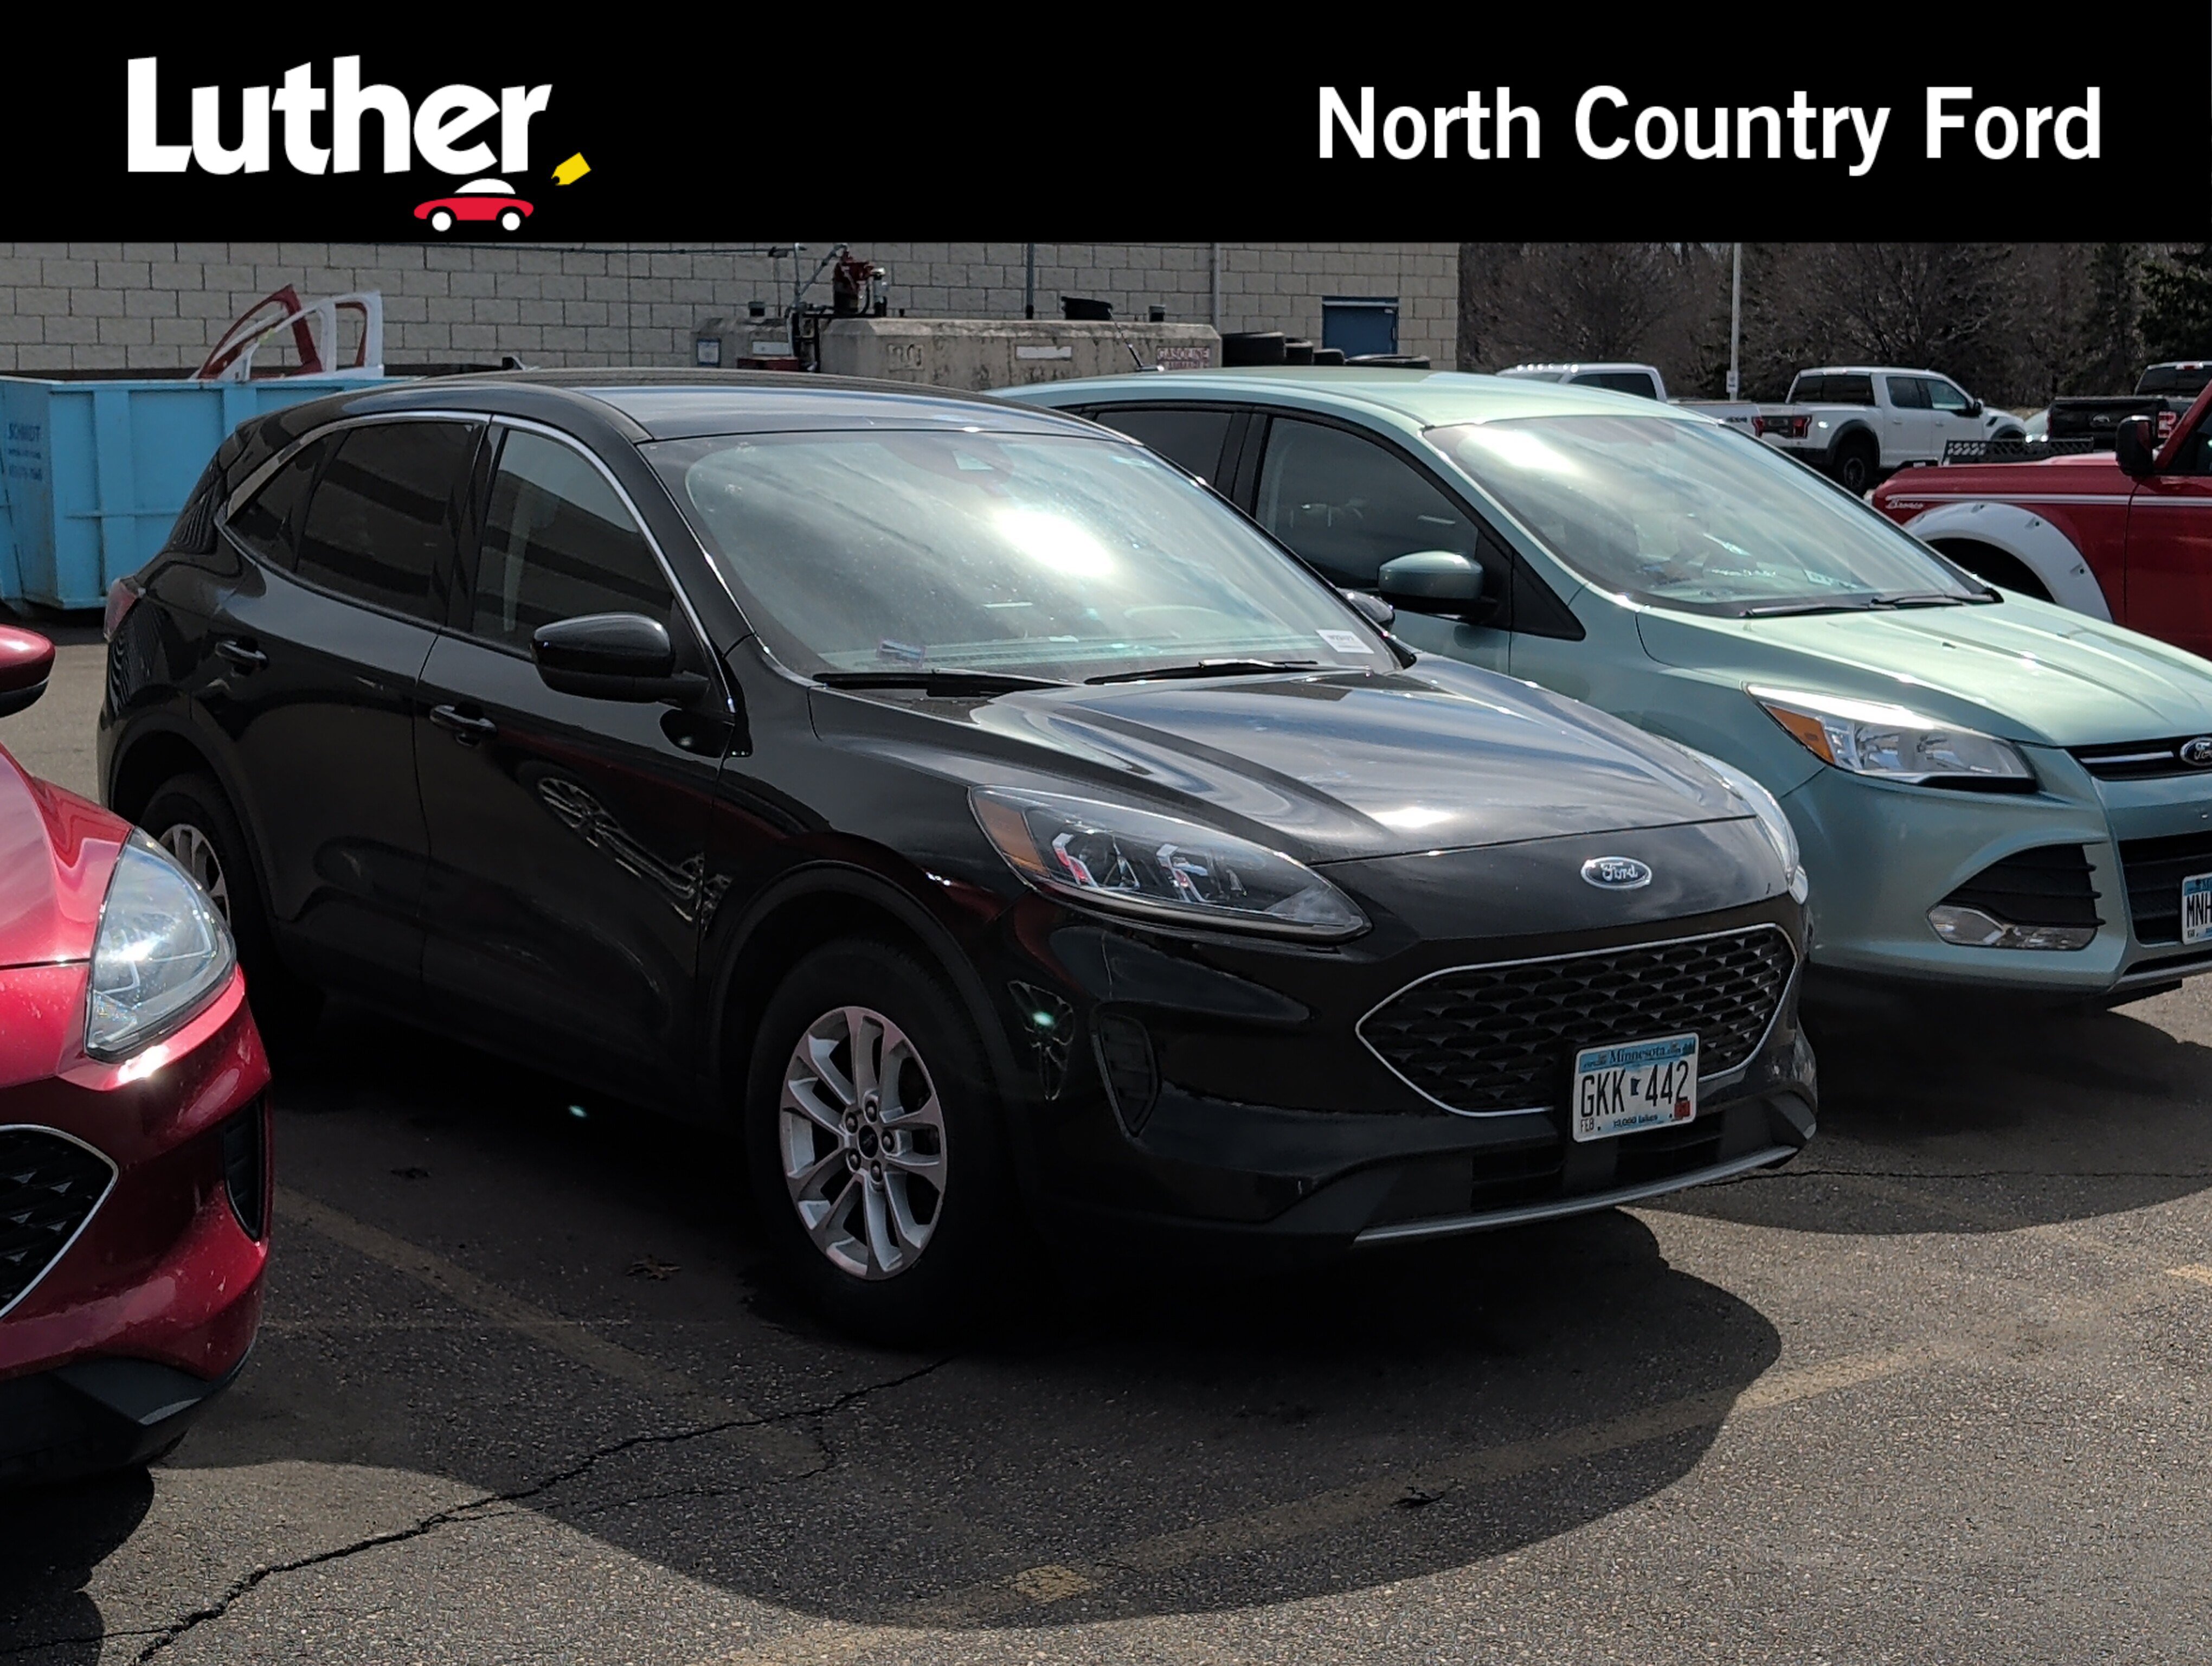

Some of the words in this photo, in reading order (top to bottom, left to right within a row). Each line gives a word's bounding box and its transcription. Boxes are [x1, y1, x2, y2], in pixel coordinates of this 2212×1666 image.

[1600, 862, 1638, 881] Ford
[1609, 1045, 1666, 1064] Minnesota
[1580, 1067, 1626, 1118] GKK
[1645, 1060, 1690, 1107] 442
